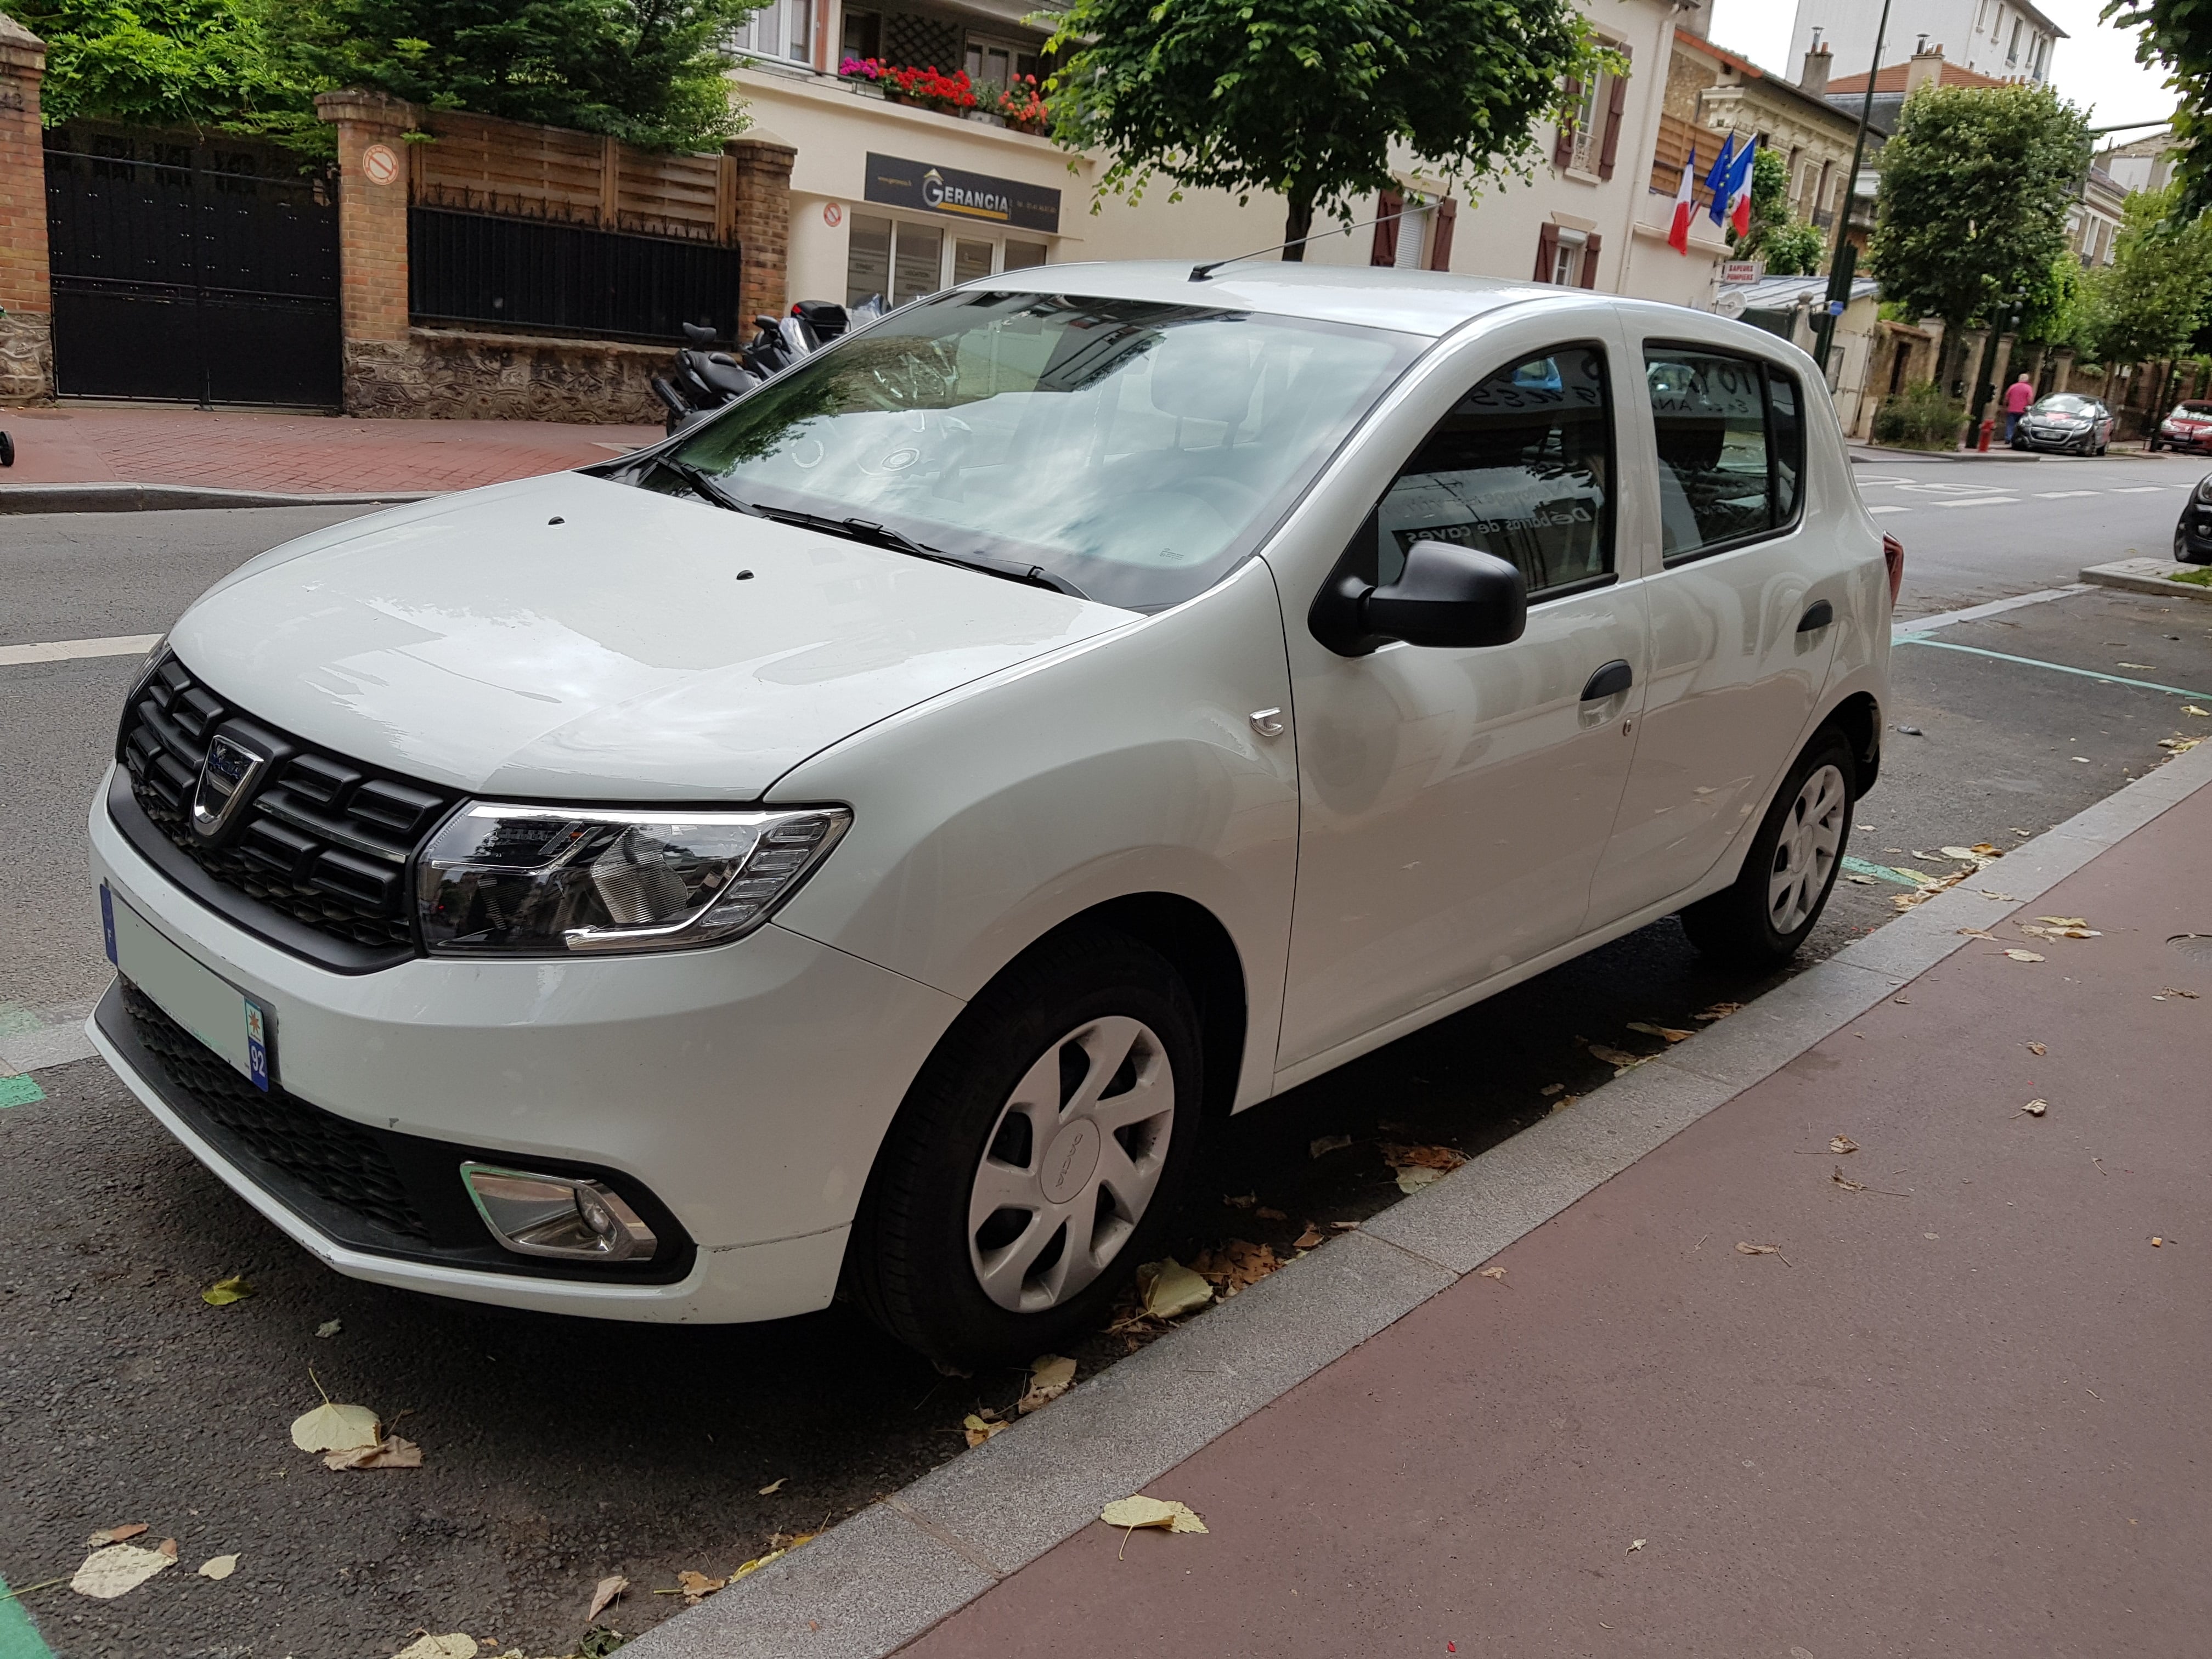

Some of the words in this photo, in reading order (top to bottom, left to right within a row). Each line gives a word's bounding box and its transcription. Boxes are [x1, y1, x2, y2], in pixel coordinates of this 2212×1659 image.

[922, 175, 1008, 212] GERANCIA
[251, 1045, 266, 1077] 92
[1055, 1133, 1084, 1188] DACIA
